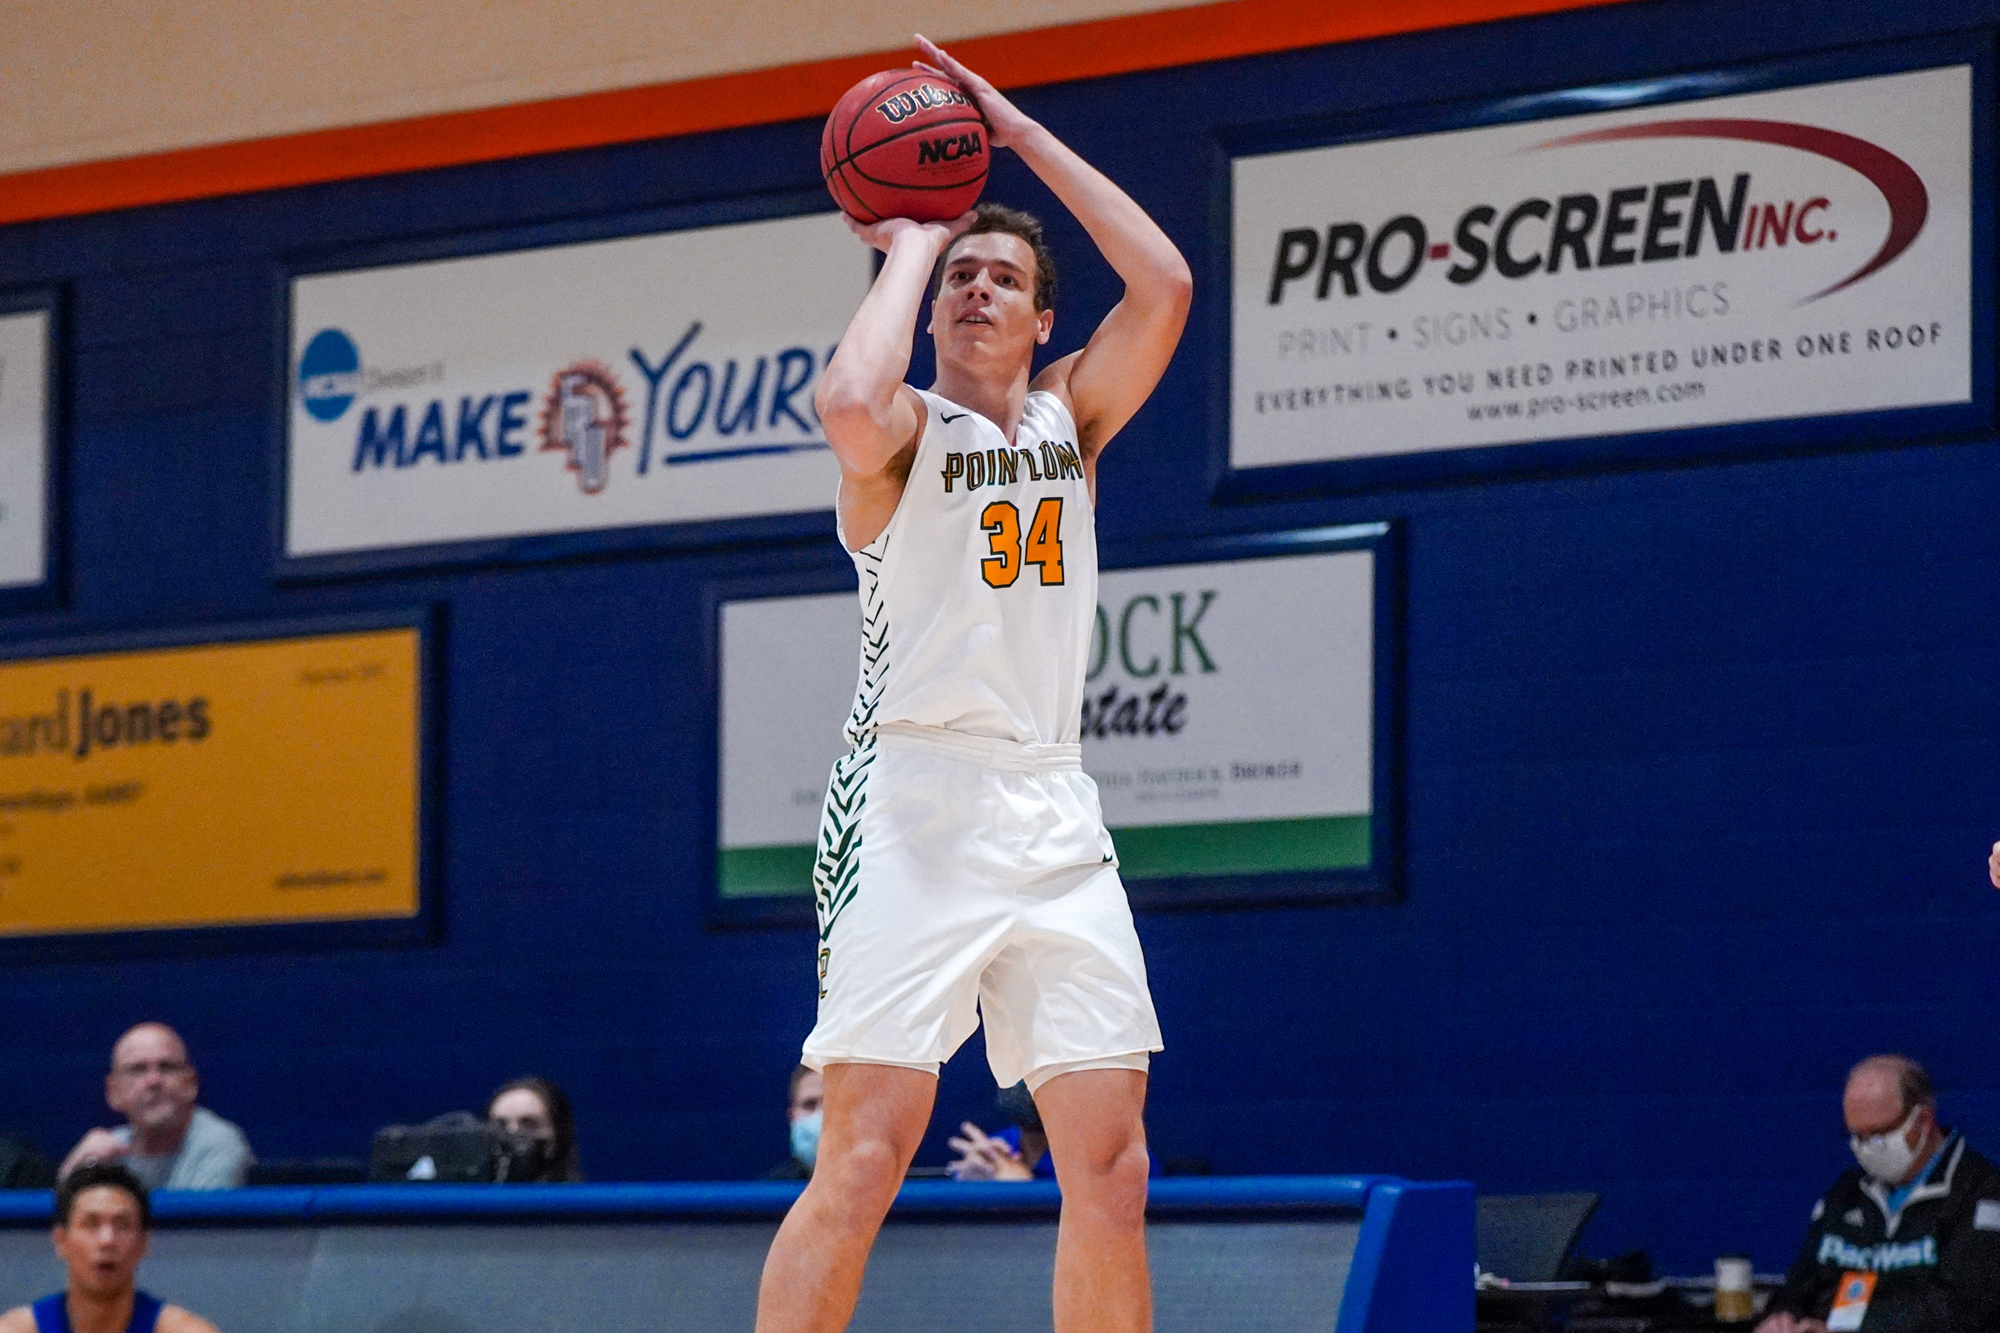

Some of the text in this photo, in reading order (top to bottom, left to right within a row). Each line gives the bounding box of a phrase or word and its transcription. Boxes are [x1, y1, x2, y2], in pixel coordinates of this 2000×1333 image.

[918, 132, 982, 165] NCAA
[1278, 281, 1730, 358] PRINT SIGNS GRAPHICS
[1255, 322, 1942, 414] EVERYTHING YOU NEED PRINTED UNDER ONE ROOF
[352, 390, 532, 474] MAKE
[941, 447, 1028, 493] POIN
[980, 497, 1065, 589] 34
